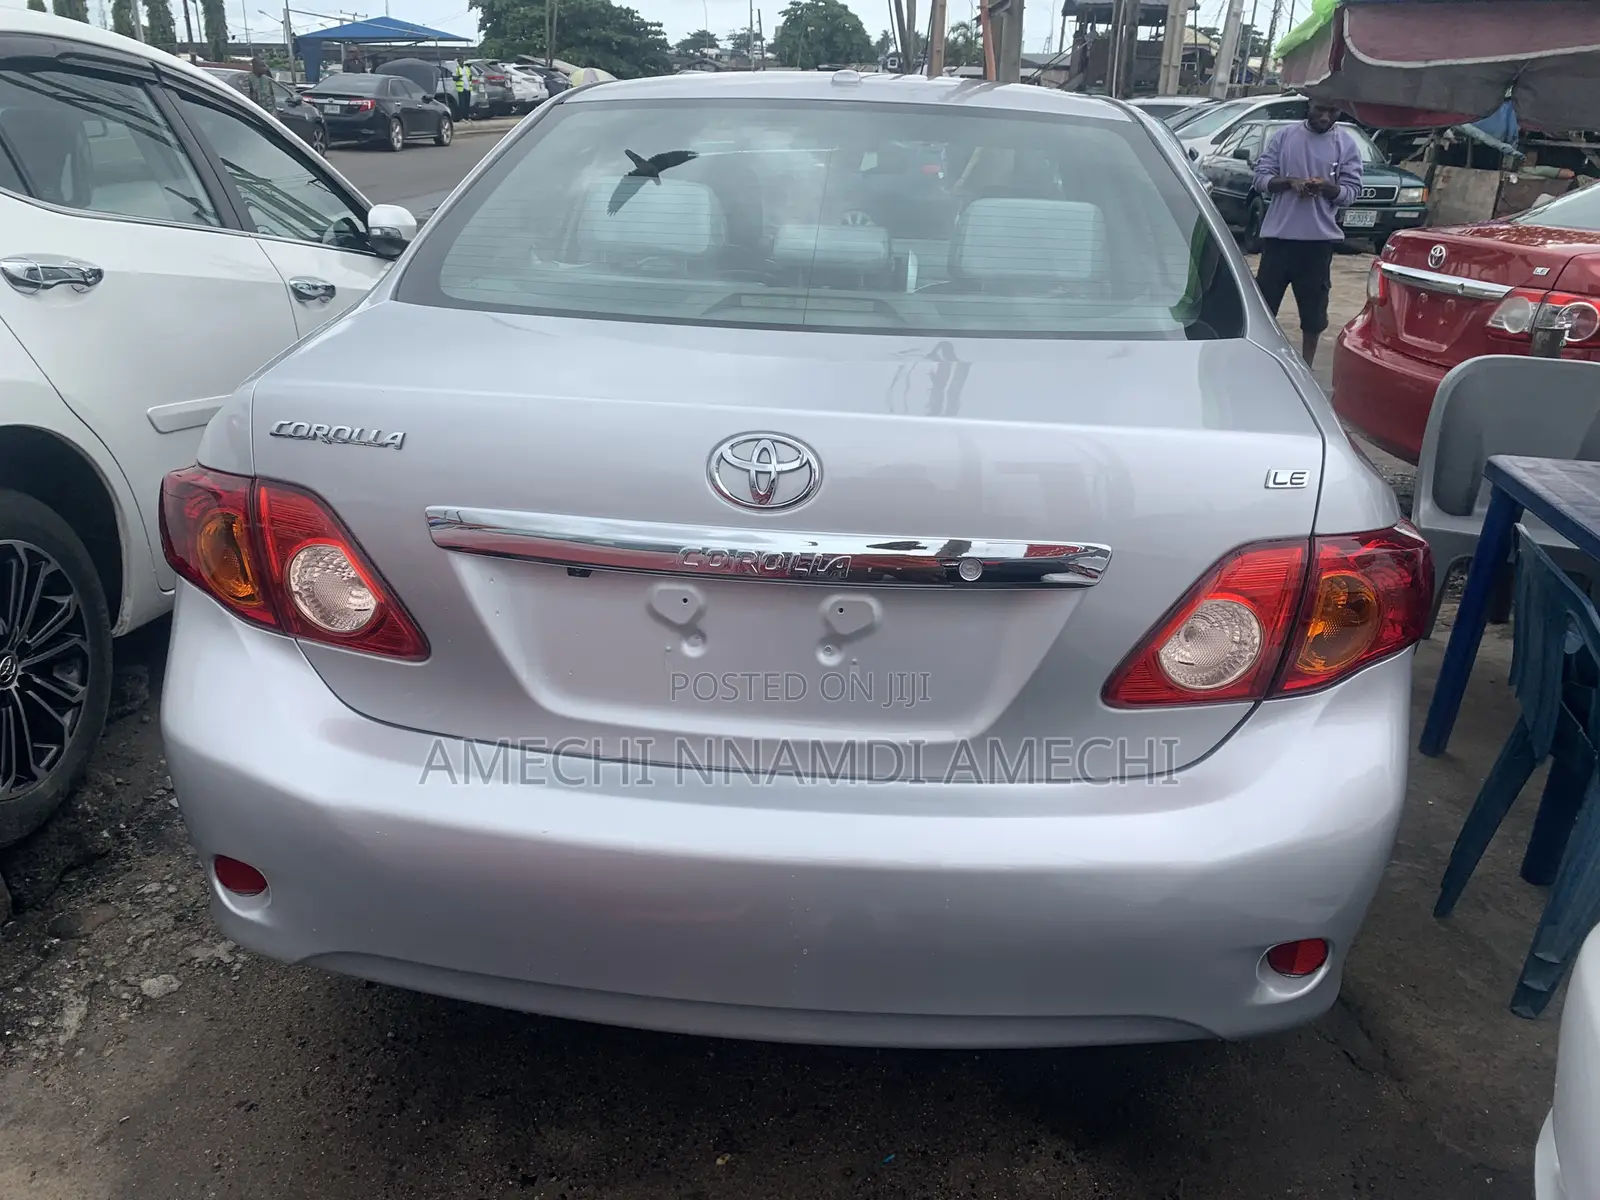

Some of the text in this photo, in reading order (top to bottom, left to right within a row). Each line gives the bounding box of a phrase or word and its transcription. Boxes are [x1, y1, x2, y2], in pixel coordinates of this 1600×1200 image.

[269, 420, 406, 451] COROLLA
[1271, 470, 1308, 487] LE
[678, 546, 852, 578] COROLLA
